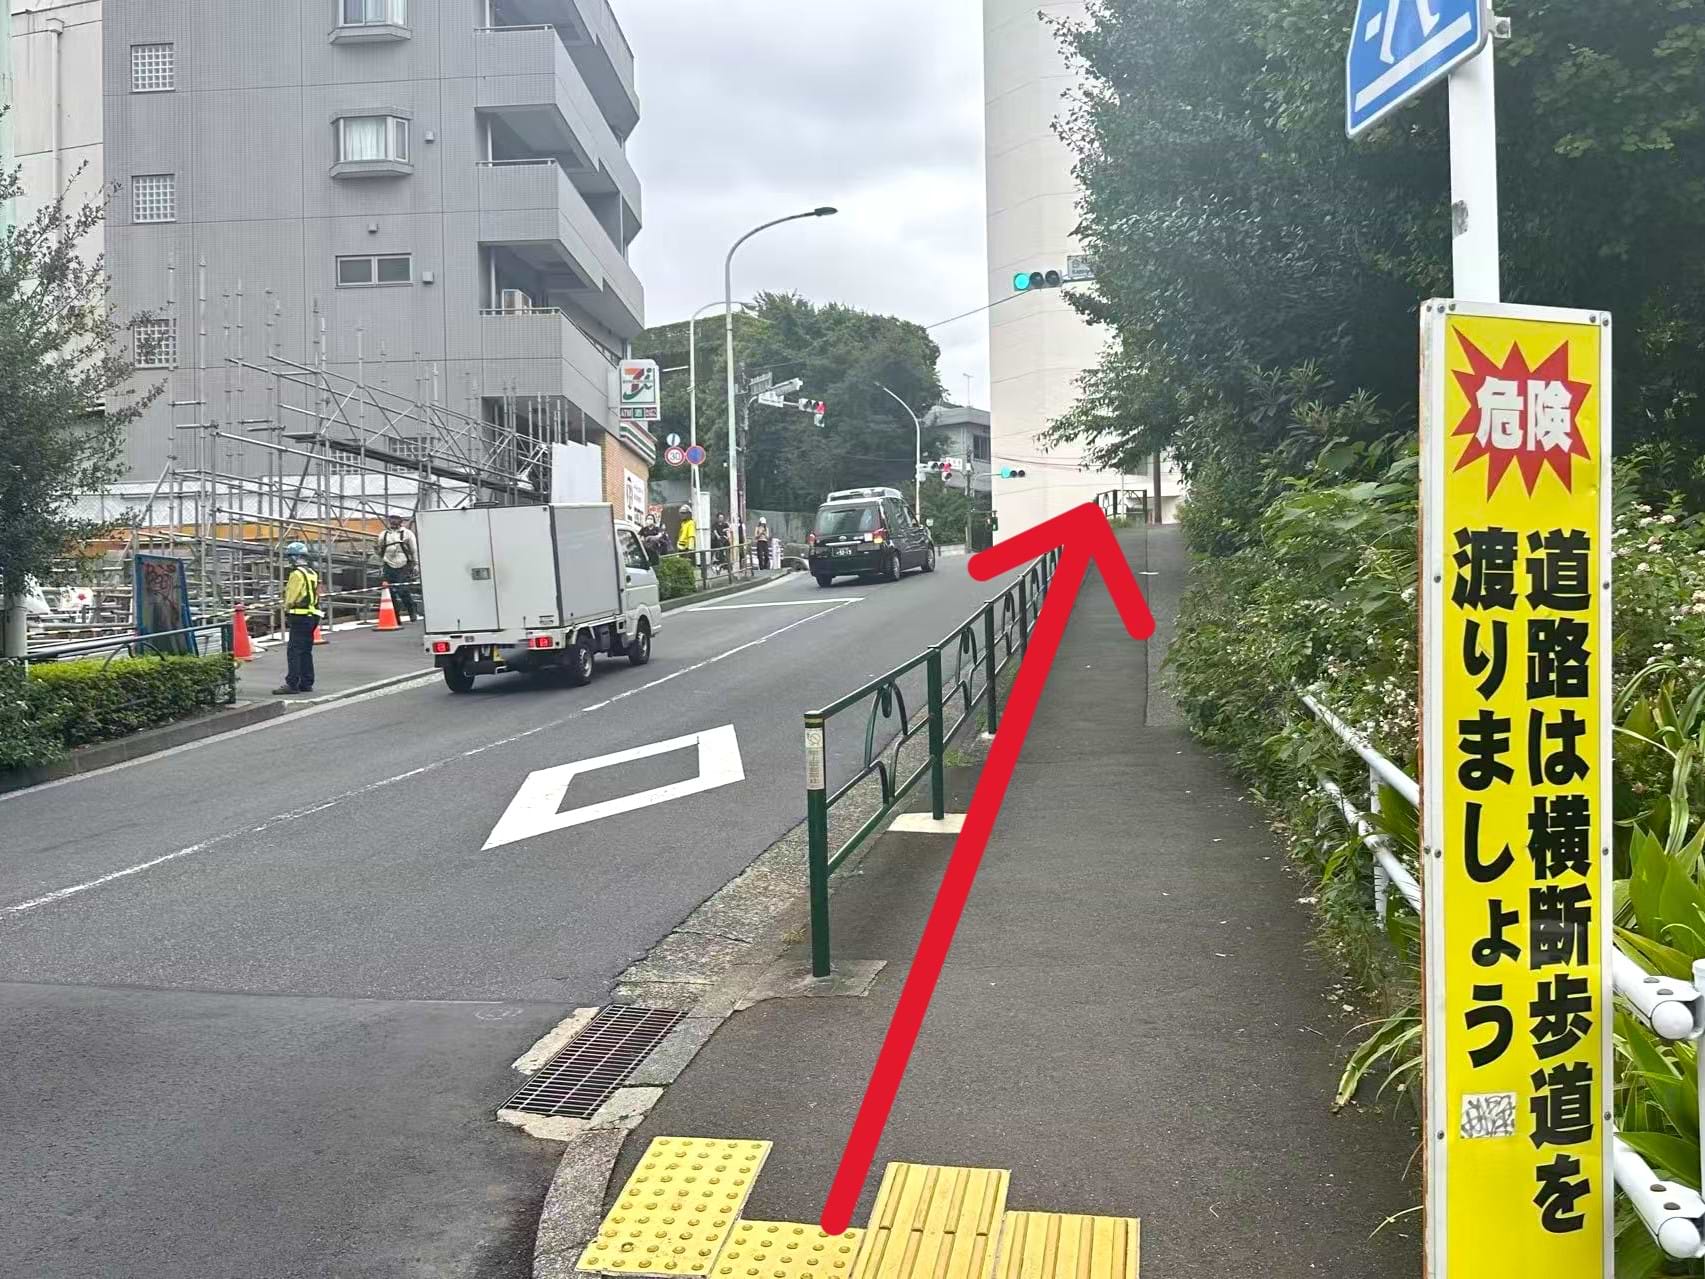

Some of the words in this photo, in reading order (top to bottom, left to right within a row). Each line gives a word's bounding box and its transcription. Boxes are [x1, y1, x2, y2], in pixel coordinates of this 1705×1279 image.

[670, 452, 680, 460] 30
[1475, 376, 1573, 453] 危険
[1452, 527, 1521, 1069] 渡りましょう
[1525, 528, 1594, 1235] 道路は横断歩道を
